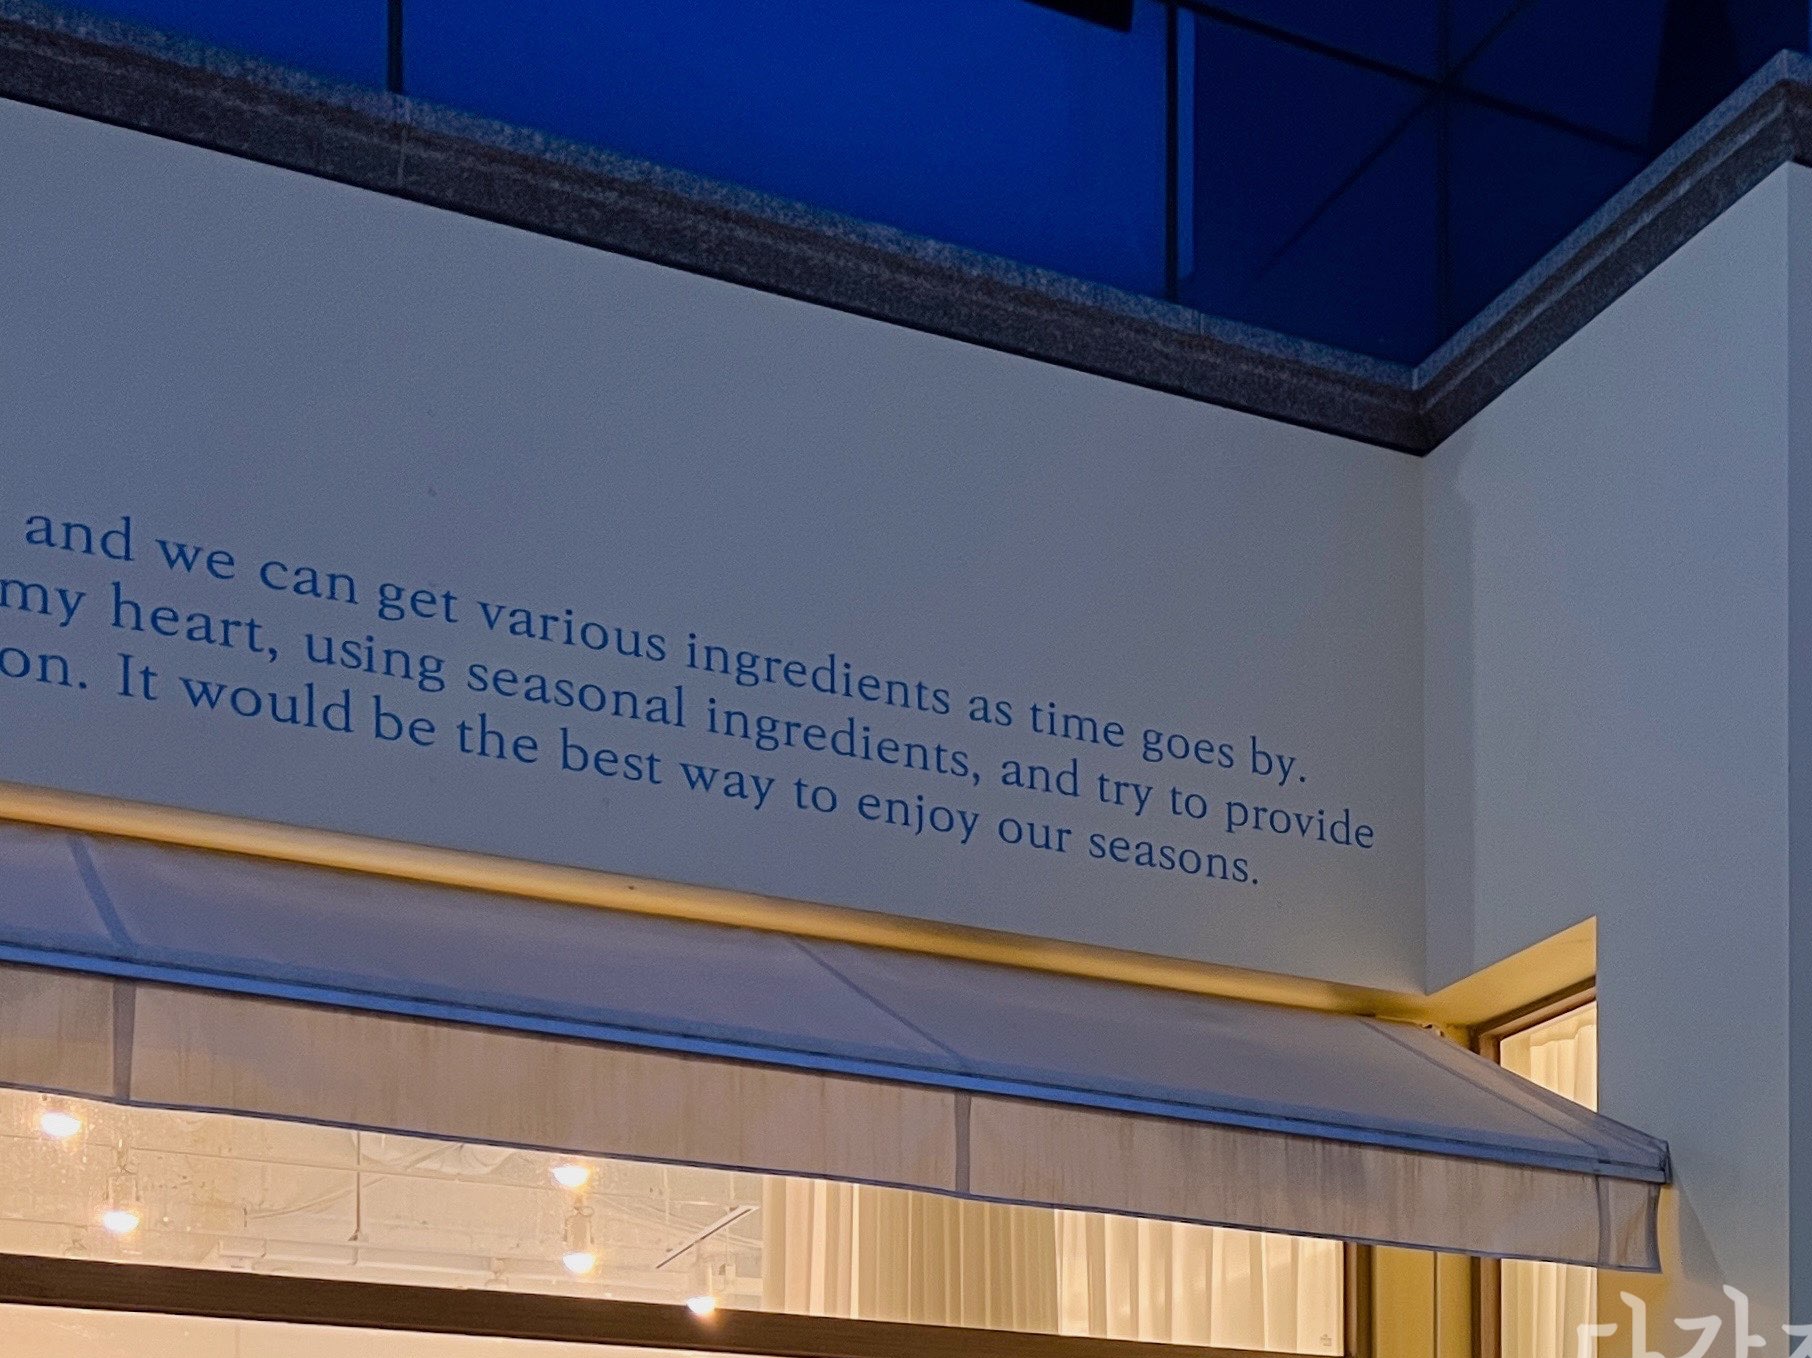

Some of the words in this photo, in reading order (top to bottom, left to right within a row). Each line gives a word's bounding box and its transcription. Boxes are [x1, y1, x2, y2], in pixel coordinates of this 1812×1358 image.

[0, 579, 87, 628] my
[111, 580, 278, 663] heart,
[305, 633, 446, 693] using
[467, 663, 685, 728] seasonal
[706, 696, 982, 786] ingredients,
[1001, 757, 1080, 798] and
[1097, 773, 1153, 817] try
[1170, 786, 1208, 820] to
[1225, 800, 1375, 849] provide
[0, 647, 88, 690] on.
[118, 652, 158, 701] It
[179, 677, 353, 734] would
[372, 694, 436, 747] be
[456, 712, 539, 764] the
[560, 726, 662, 785] best
[680, 762, 776, 811] way
[794, 778, 838, 813] to
[857, 793, 980, 845] enjoy
[997, 817, 1073, 853] our
[1088, 833, 1259, 885] seasons.
[25, 515, 134, 562] and
[155, 538, 235, 580] we
[259, 560, 358, 605] can
[377, 582, 459, 623] get
[477, 601, 667, 662] various
[687, 632, 950, 715] ingredients
[968, 696, 1013, 727] as
[1030, 701, 1125, 748] time
[1142, 729, 1235, 769] goes
[1250, 735, 1306, 787] by.
